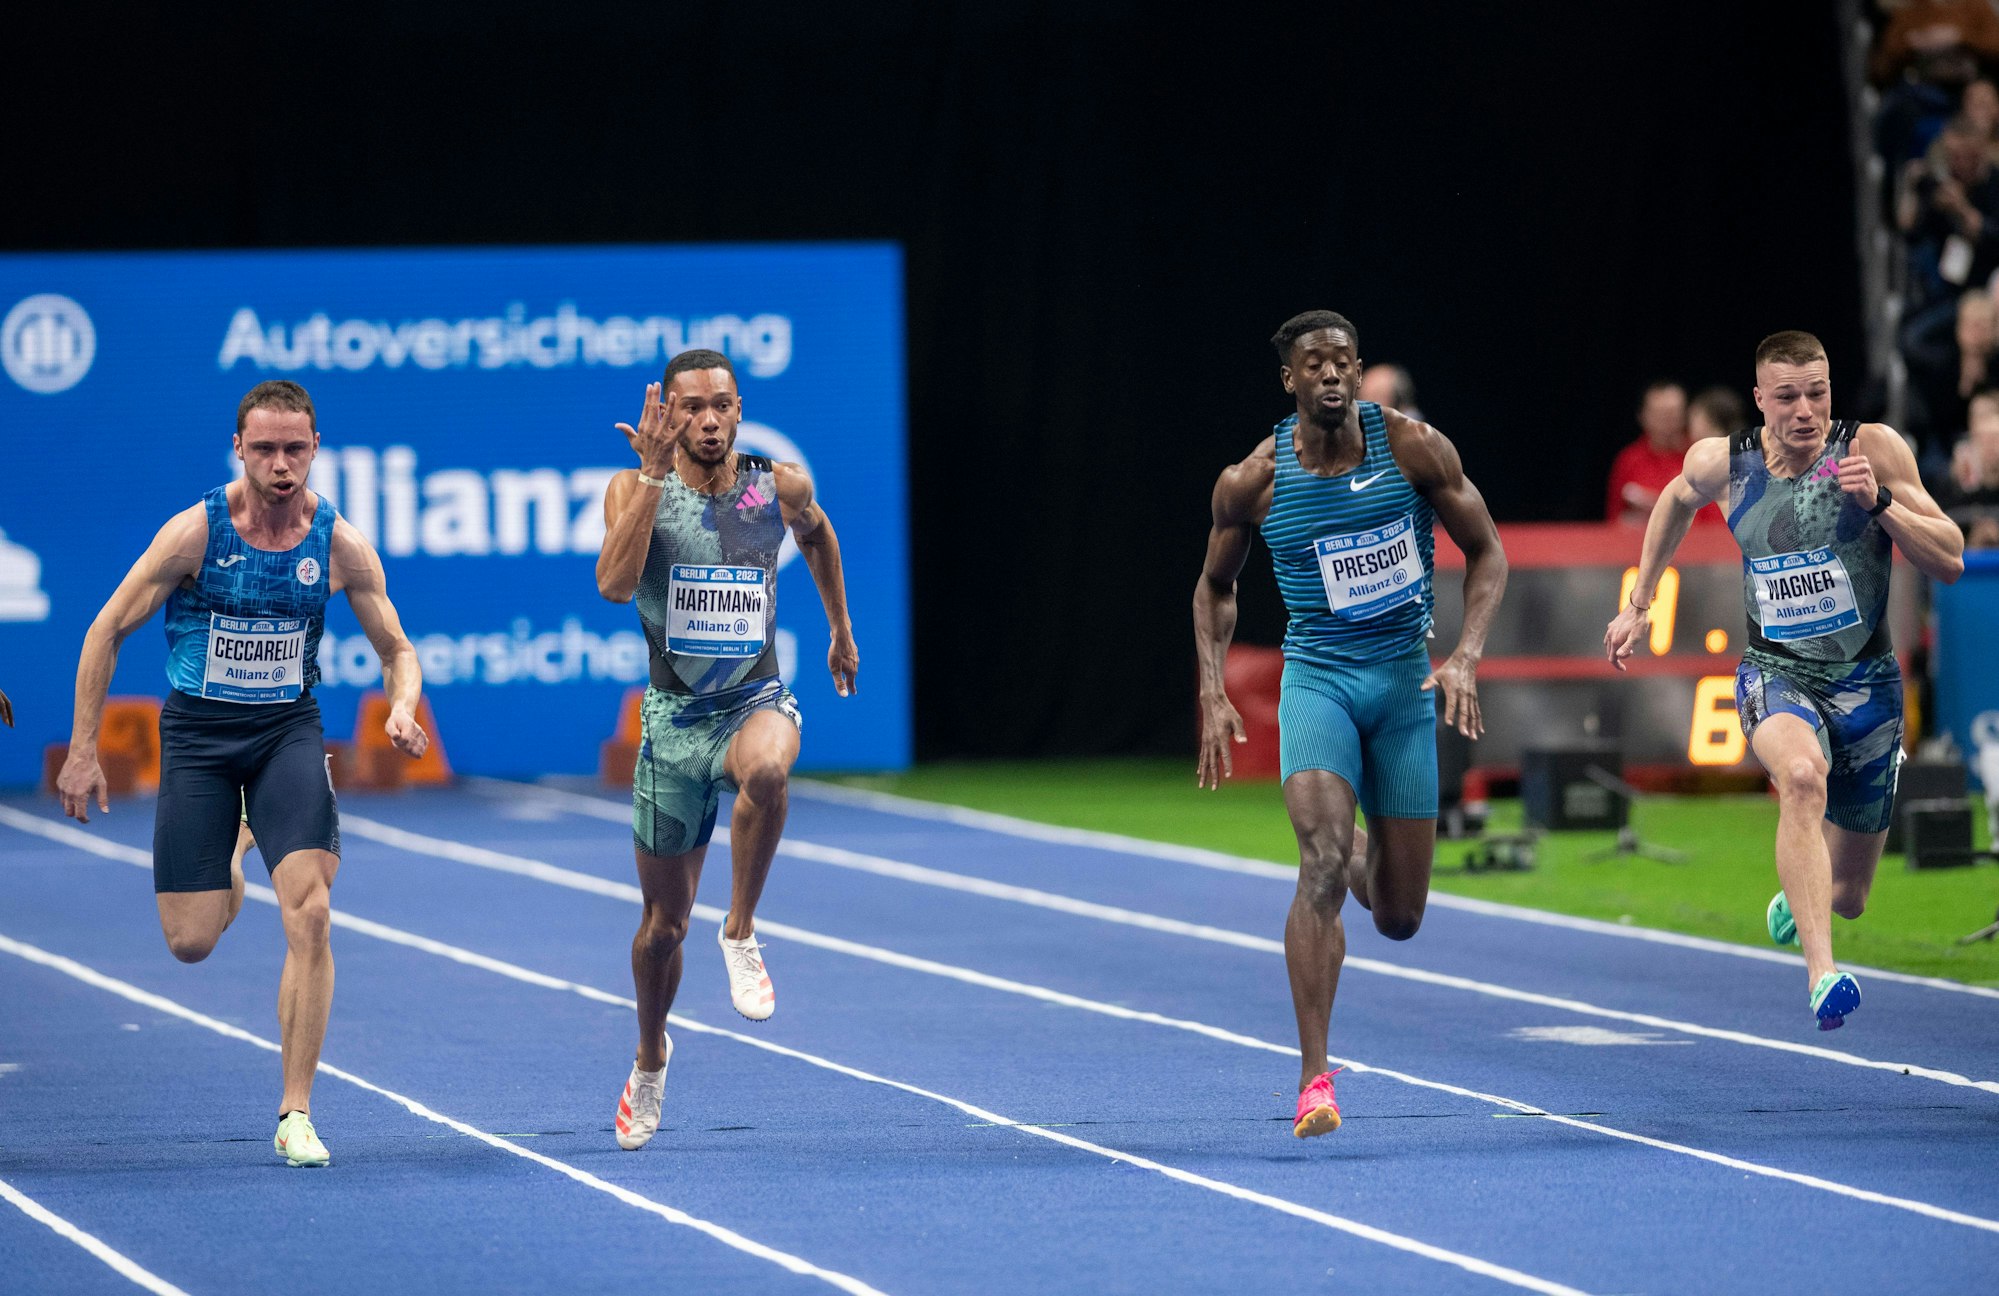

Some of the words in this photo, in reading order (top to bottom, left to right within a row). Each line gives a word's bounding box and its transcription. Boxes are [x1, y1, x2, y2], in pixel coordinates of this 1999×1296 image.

[218, 303, 792, 378] Autoversicherung
[228, 444, 636, 557] llianz
[1324, 537, 1353, 551] BERLIN
[1382, 522, 1405, 539] 2023
[1332, 539, 1408, 582] PRESCOD
[1754, 559, 1780, 571] BERLIN
[679, 568, 707, 579] BERLIN
[736, 570, 758, 581] 2023
[1765, 569, 1836, 601] WAGNER
[675, 587, 761, 613] HARTMANN
[1349, 577, 1392, 598] Allianz
[1776, 604, 1818, 619] Allianz
[220, 619, 249, 631] BERLIN
[278, 621, 300, 631] 2023
[686, 619, 731, 632] Allianz
[215, 636, 300, 661] CECCARELLI
[225, 666, 269, 680] Allianz
[1688, 675, 1747, 766] 6
